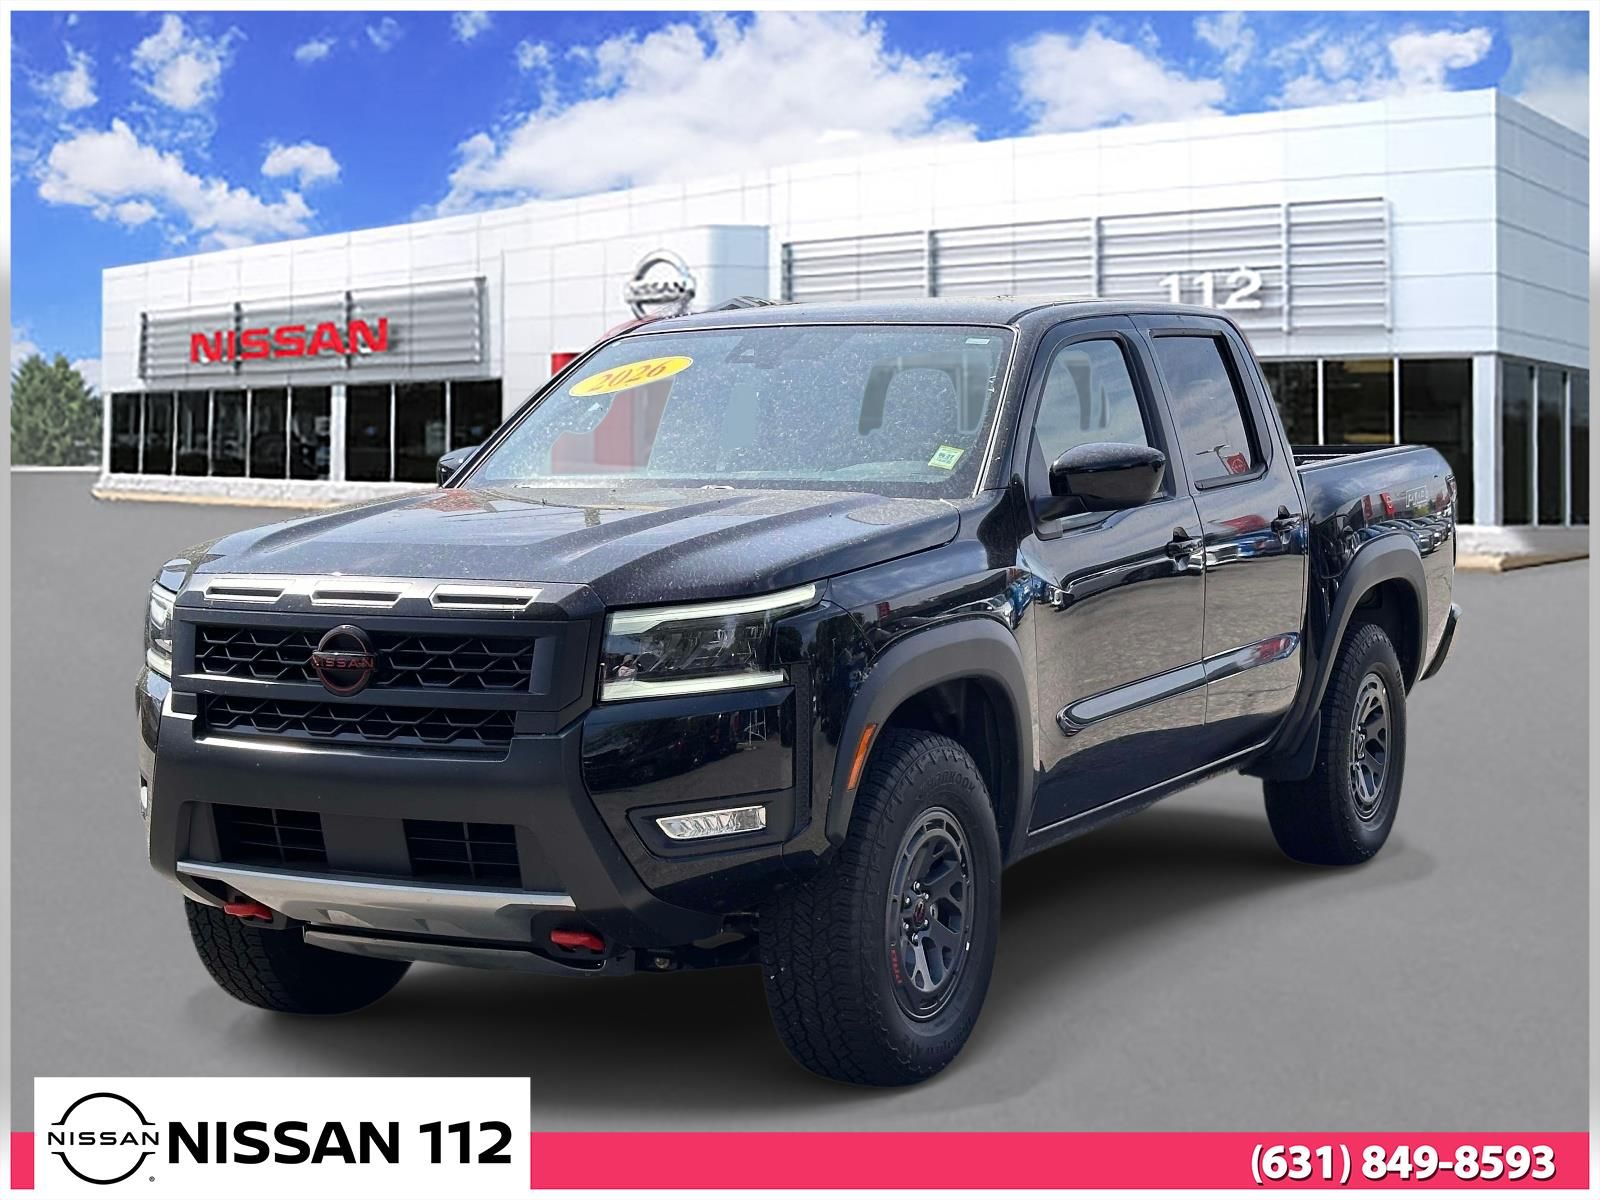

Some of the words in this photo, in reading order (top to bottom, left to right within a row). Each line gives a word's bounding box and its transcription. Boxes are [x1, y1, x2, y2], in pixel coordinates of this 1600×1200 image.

[1159, 270, 1262, 310] 112
[190, 317, 388, 363] NISSAN
[586, 360, 674, 392] 2026
[311, 655, 375, 669] NISSAN
